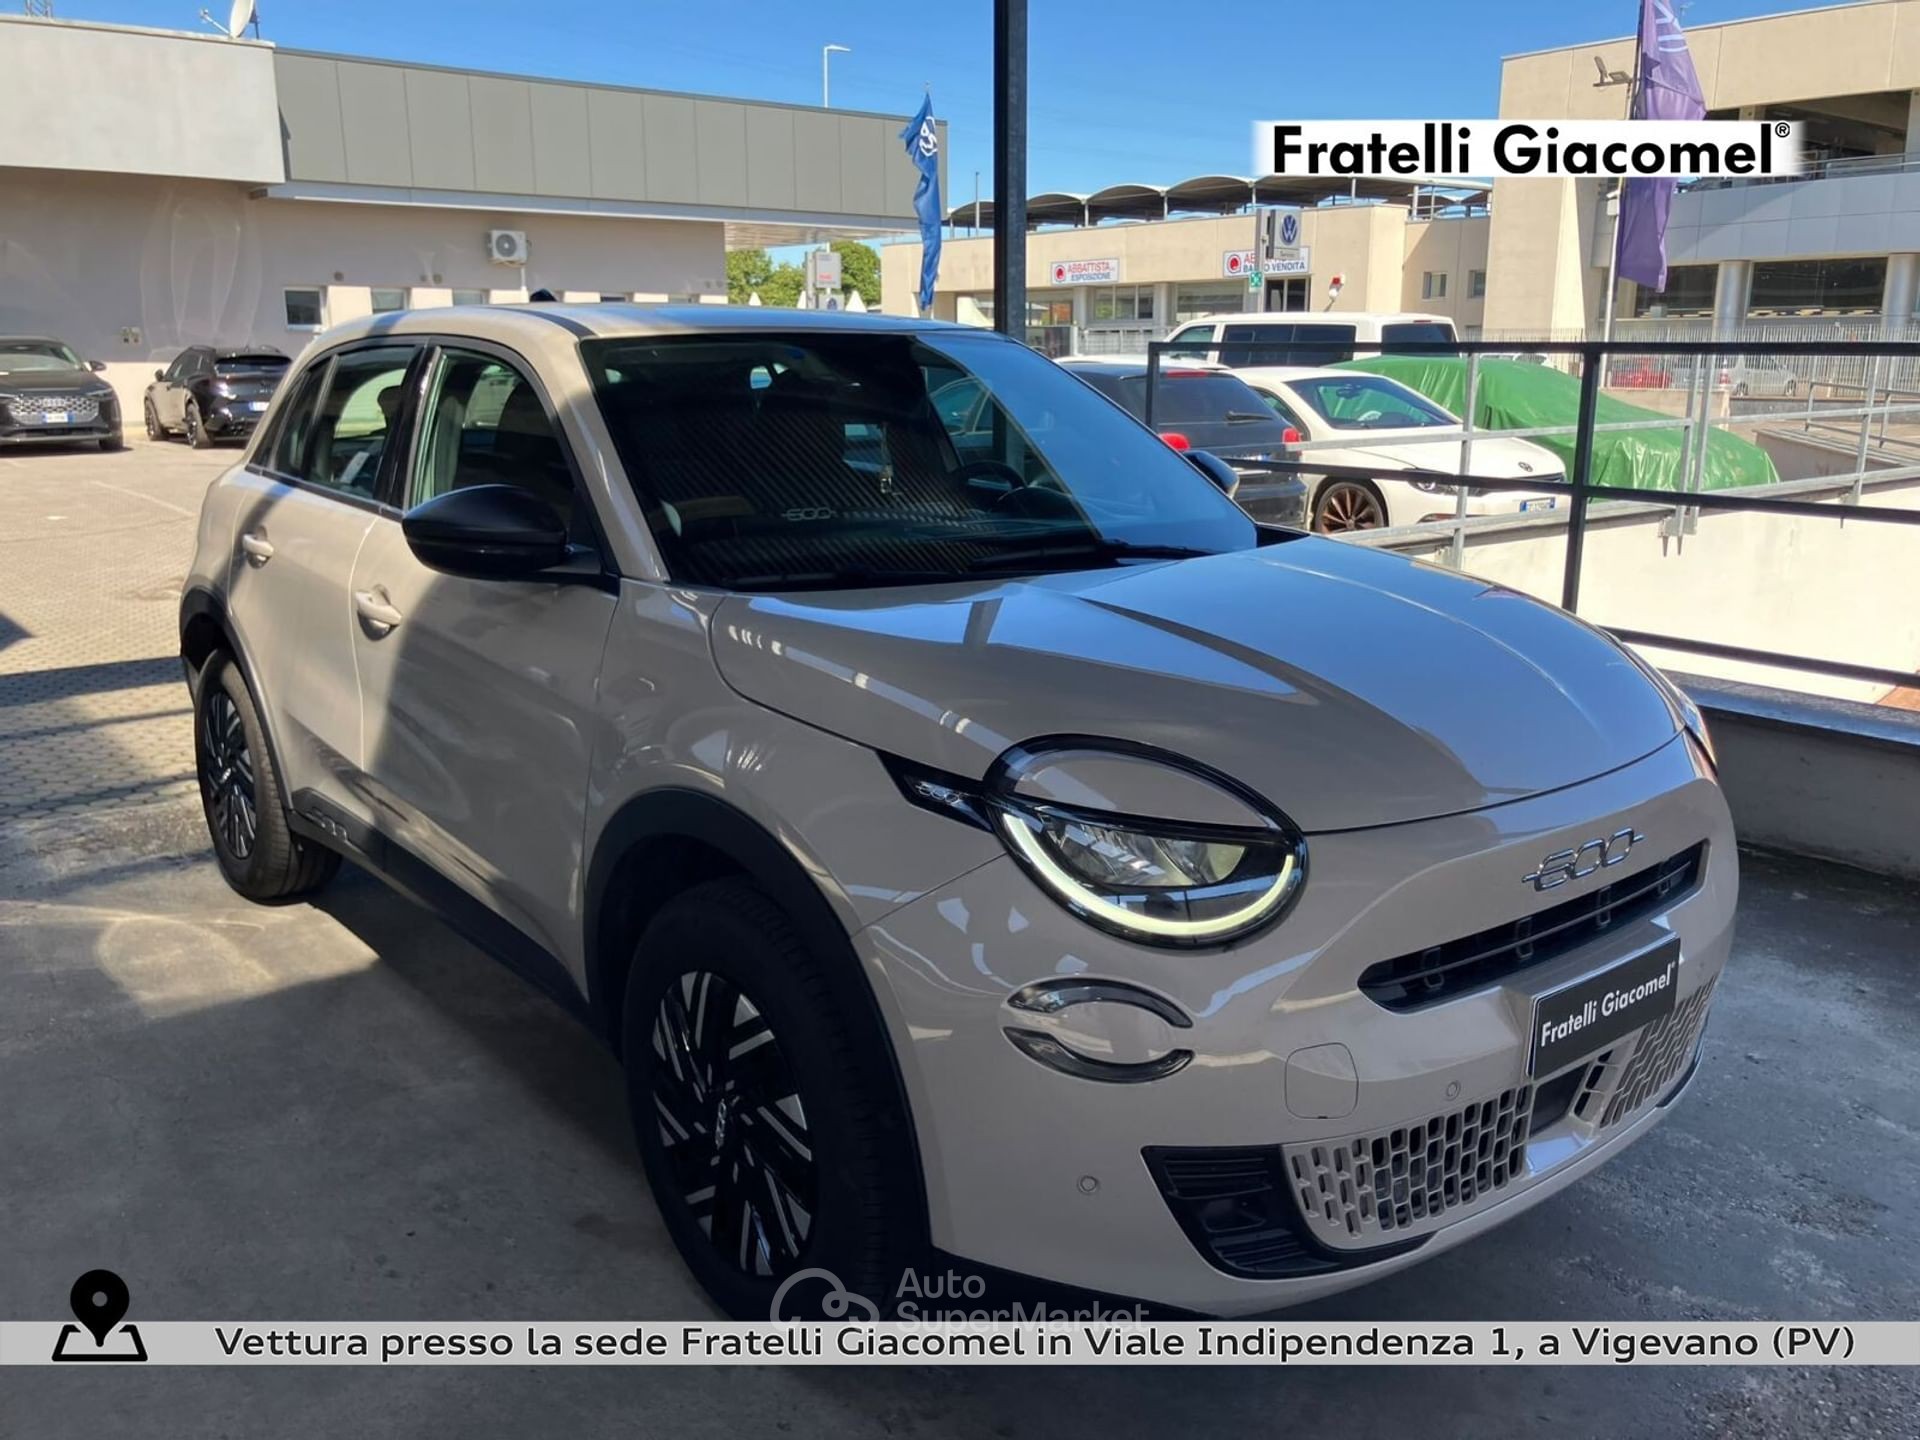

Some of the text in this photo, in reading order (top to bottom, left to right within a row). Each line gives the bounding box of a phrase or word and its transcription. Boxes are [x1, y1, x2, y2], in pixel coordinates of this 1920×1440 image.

[1272, 261, 1305, 272] VENDITA
[1521, 827, 1645, 892] 600
[1540, 1000, 1598, 1048] Fratelli
